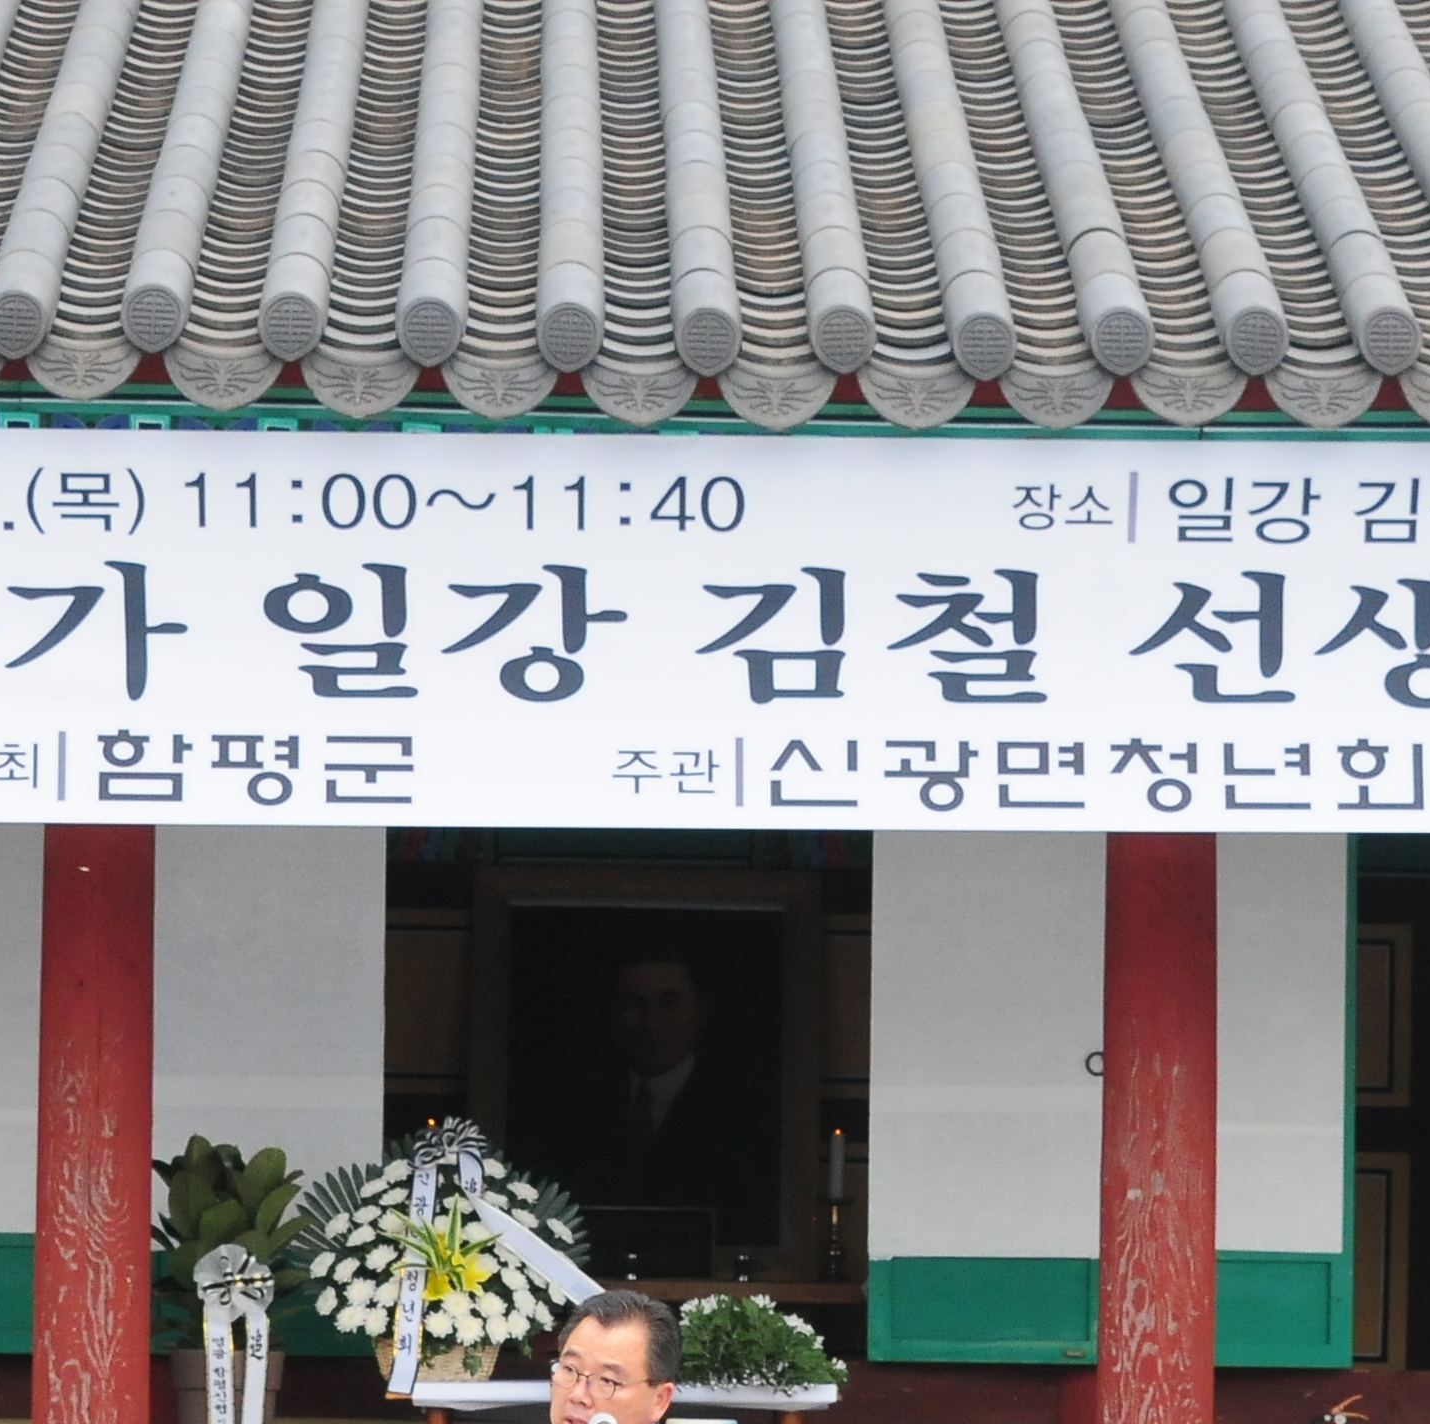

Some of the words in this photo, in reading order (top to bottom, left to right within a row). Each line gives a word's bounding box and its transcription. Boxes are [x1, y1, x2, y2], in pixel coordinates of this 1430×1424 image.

[184, 470, 745, 533] 11:00~11:40
[1012, 483, 1114, 530] 장소
[1169, 477, 1321, 544] 일강
[263, 563, 628, 703] 일강
[695, 566, 1047, 704] 김철
[97, 729, 414, 806] 함평군
[611, 748, 720, 796] 주관
[770, 738, 1424, 812] 신광면청년회
